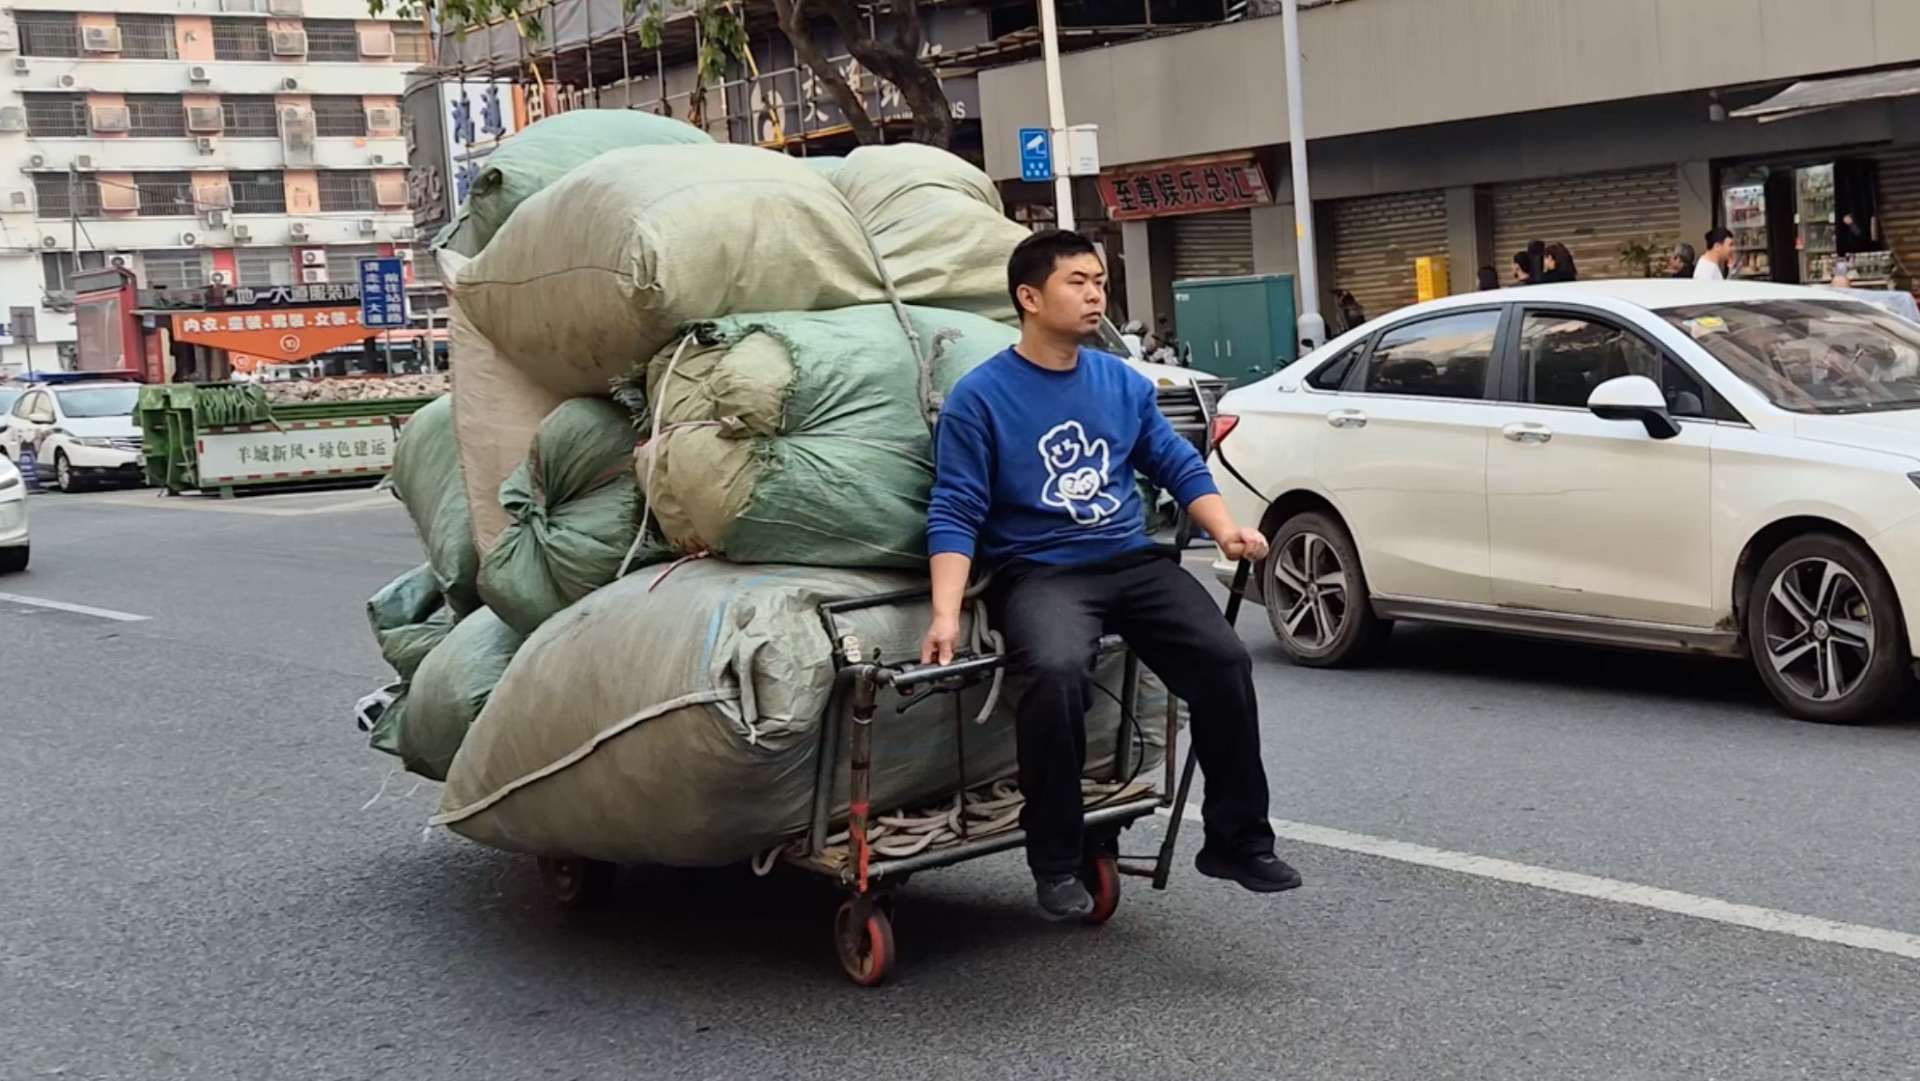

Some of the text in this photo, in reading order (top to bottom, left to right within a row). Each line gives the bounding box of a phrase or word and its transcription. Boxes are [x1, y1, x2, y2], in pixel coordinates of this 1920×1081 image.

[1111, 164, 1253, 212] 至尊娱乐总汇
[364, 261, 383, 323] 请走地一大道
